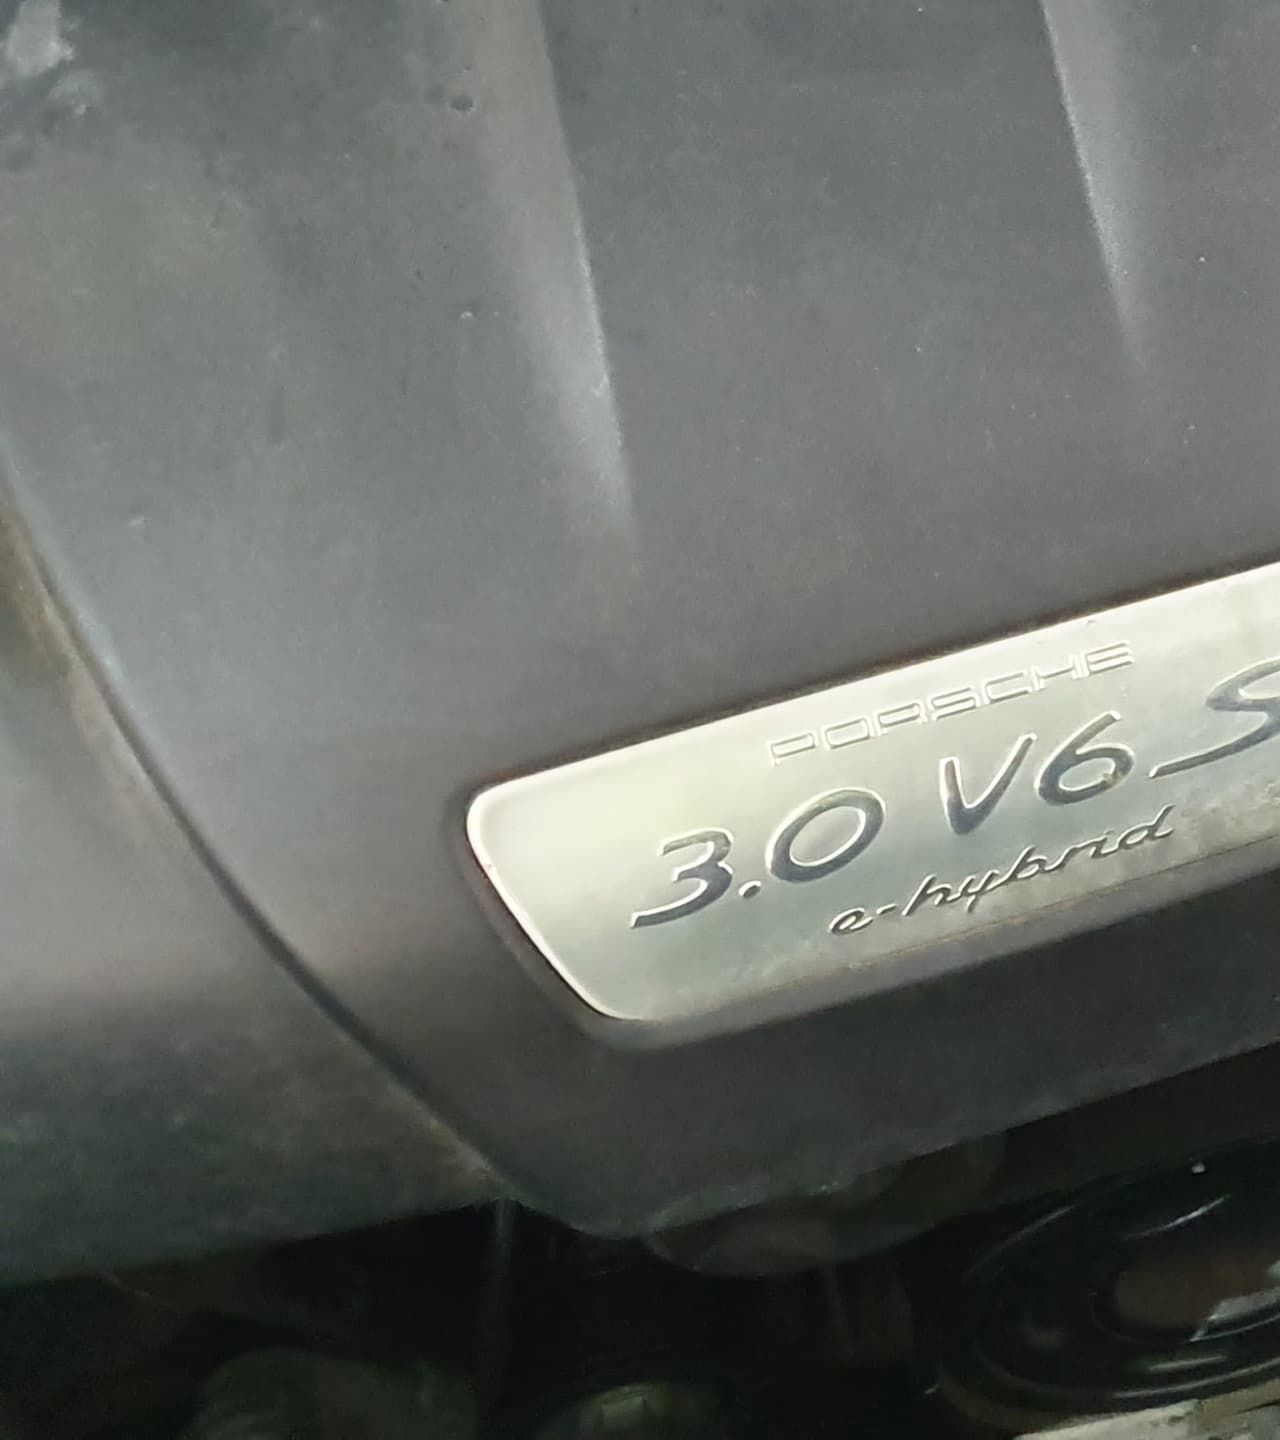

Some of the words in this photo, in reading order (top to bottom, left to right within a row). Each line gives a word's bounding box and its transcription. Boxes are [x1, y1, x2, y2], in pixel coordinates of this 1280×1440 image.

[768, 639, 1135, 765] PORSCHE
[630, 786, 887, 929] 3.0
[939, 710, 1136, 836] V6
[828, 803, 1175, 935] e-hybrid
